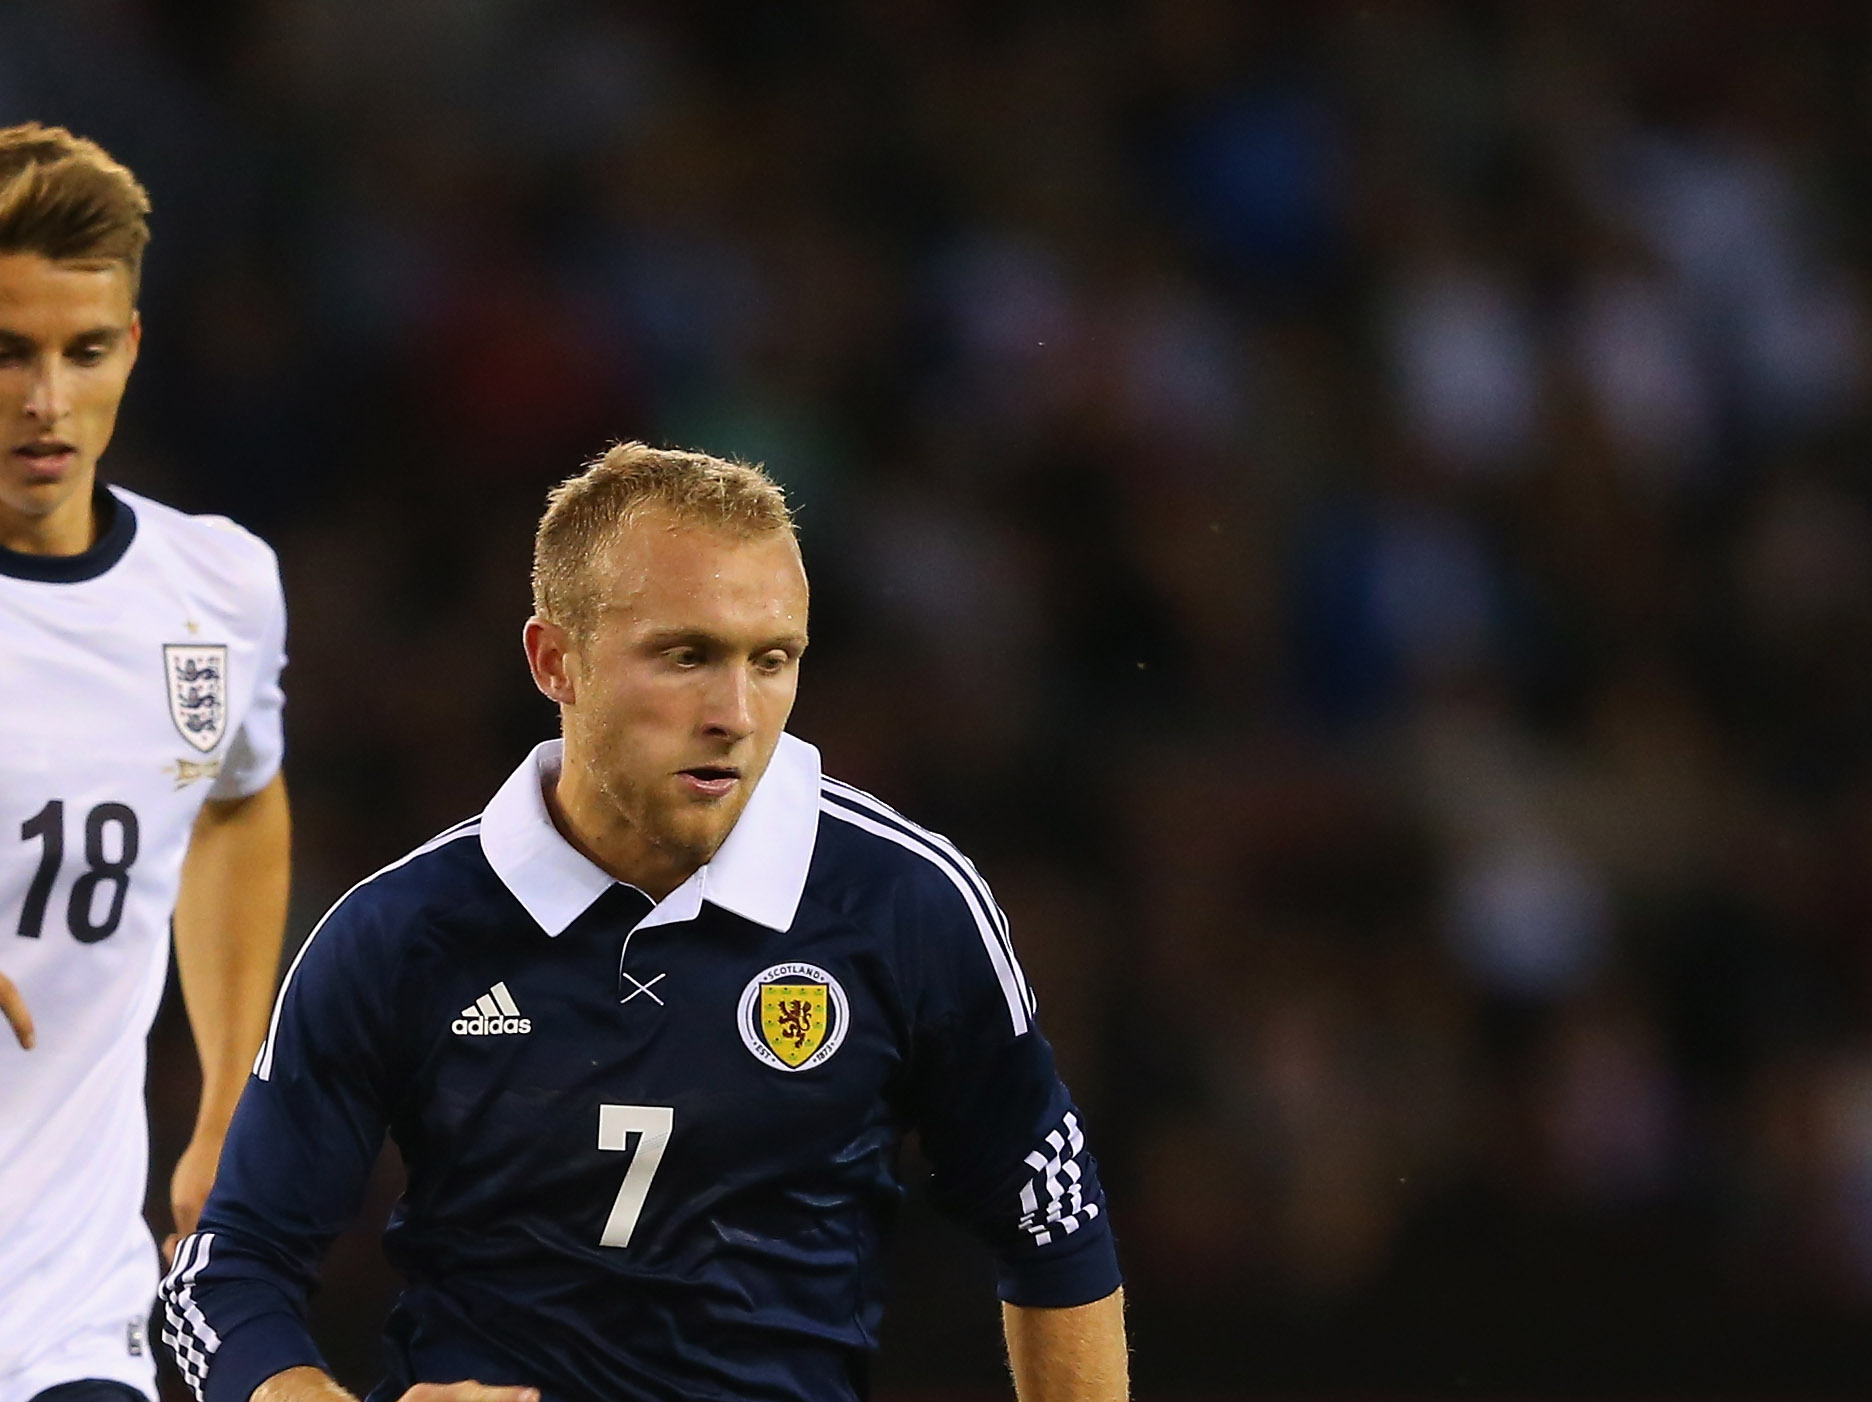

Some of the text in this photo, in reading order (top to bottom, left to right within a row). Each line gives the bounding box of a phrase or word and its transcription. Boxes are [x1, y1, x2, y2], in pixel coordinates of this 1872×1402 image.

[16, 799, 140, 944] 18
[767, 965, 821, 980] SCOTLAND
[451, 1014, 532, 1035] adidas
[755, 1044, 833, 1061] EST 1873
[598, 1104, 674, 1248] 7
